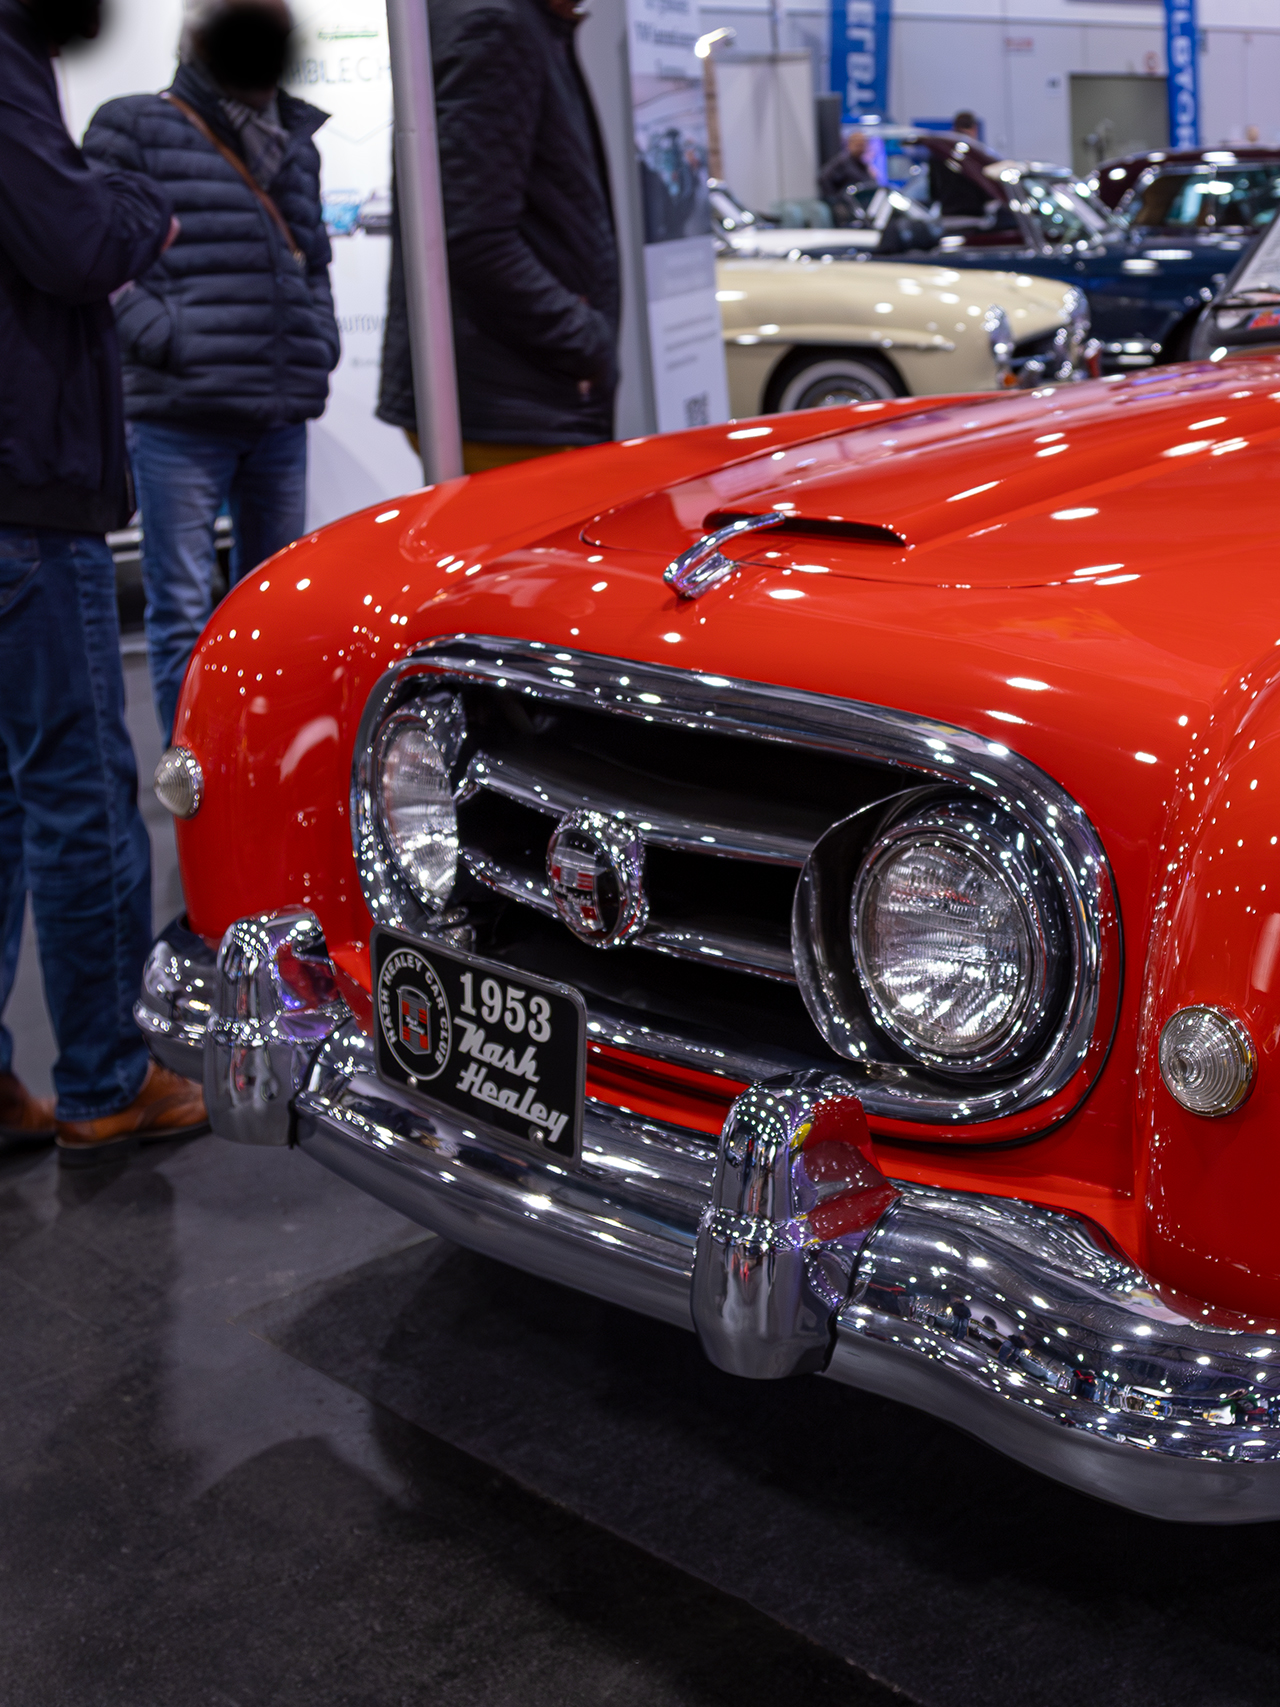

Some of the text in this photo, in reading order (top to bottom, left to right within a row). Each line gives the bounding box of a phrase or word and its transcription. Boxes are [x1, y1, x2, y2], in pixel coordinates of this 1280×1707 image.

[381, 954, 449, 1065] NASH HEALEY CAR CLUB
[460, 971, 552, 1043] 1953
[454, 1017, 540, 1083] Nash
[455, 1062, 569, 1143] Healey
